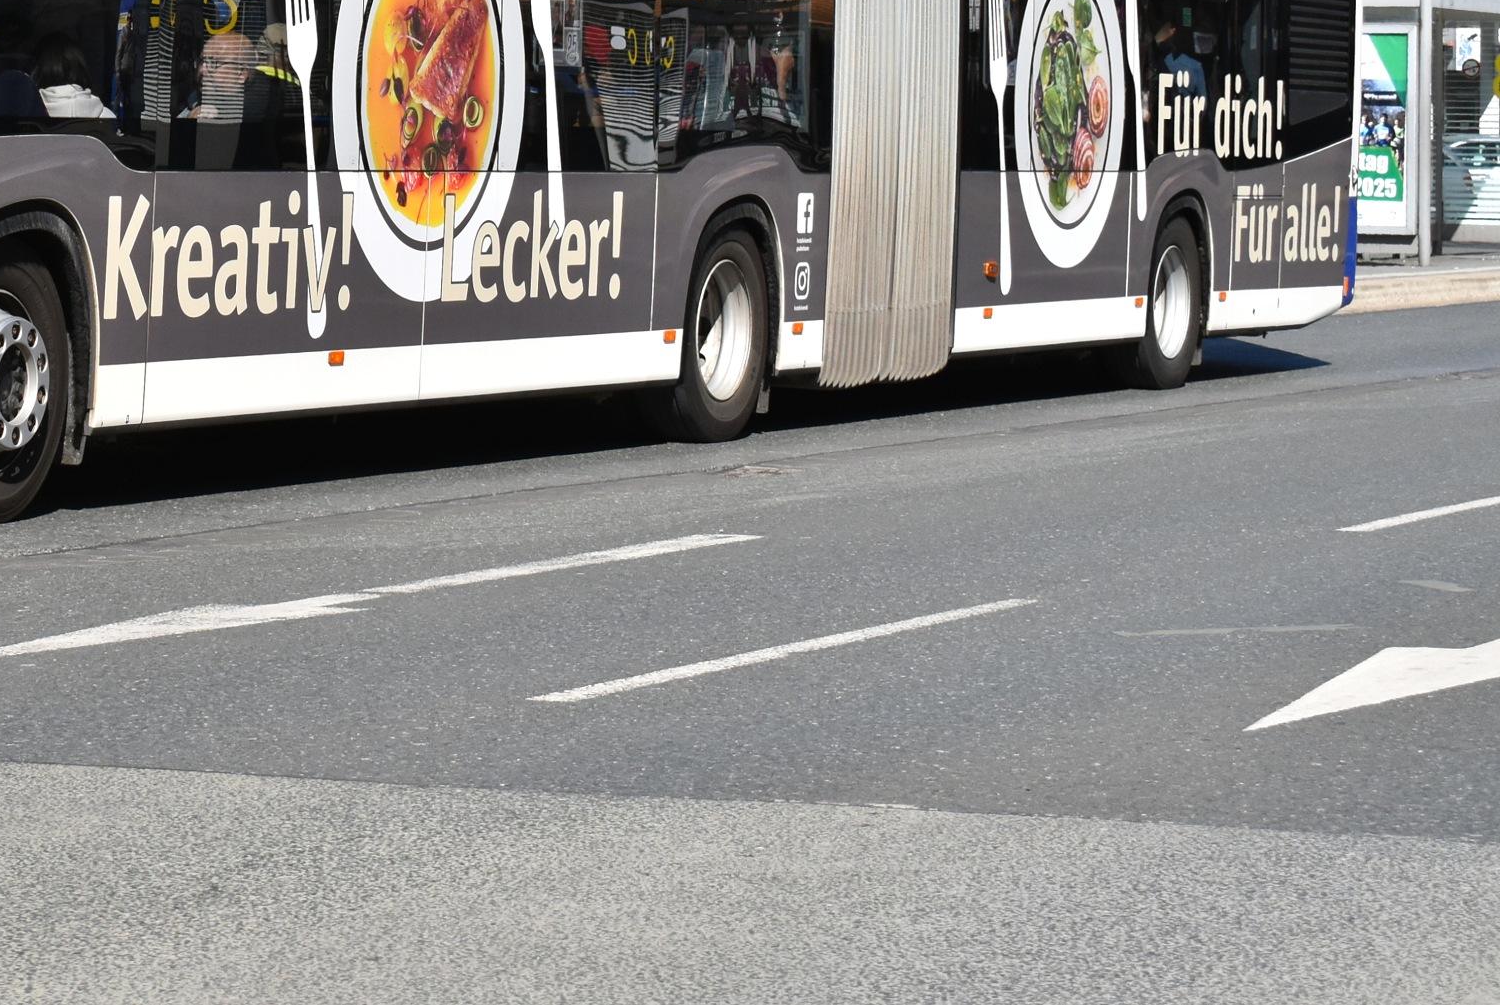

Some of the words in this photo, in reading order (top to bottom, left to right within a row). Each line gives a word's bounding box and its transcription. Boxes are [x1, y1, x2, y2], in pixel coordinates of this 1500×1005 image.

[1157, 70, 1206, 158] Für
[1214, 73, 1284, 161] dich!
[1359, 151, 1389, 175] tag
[103, 190, 355, 321] Kreativ!
[440, 189, 625, 303] Lecker!
[1235, 183, 1279, 264] Für
[1284, 182, 1341, 262] alle!
